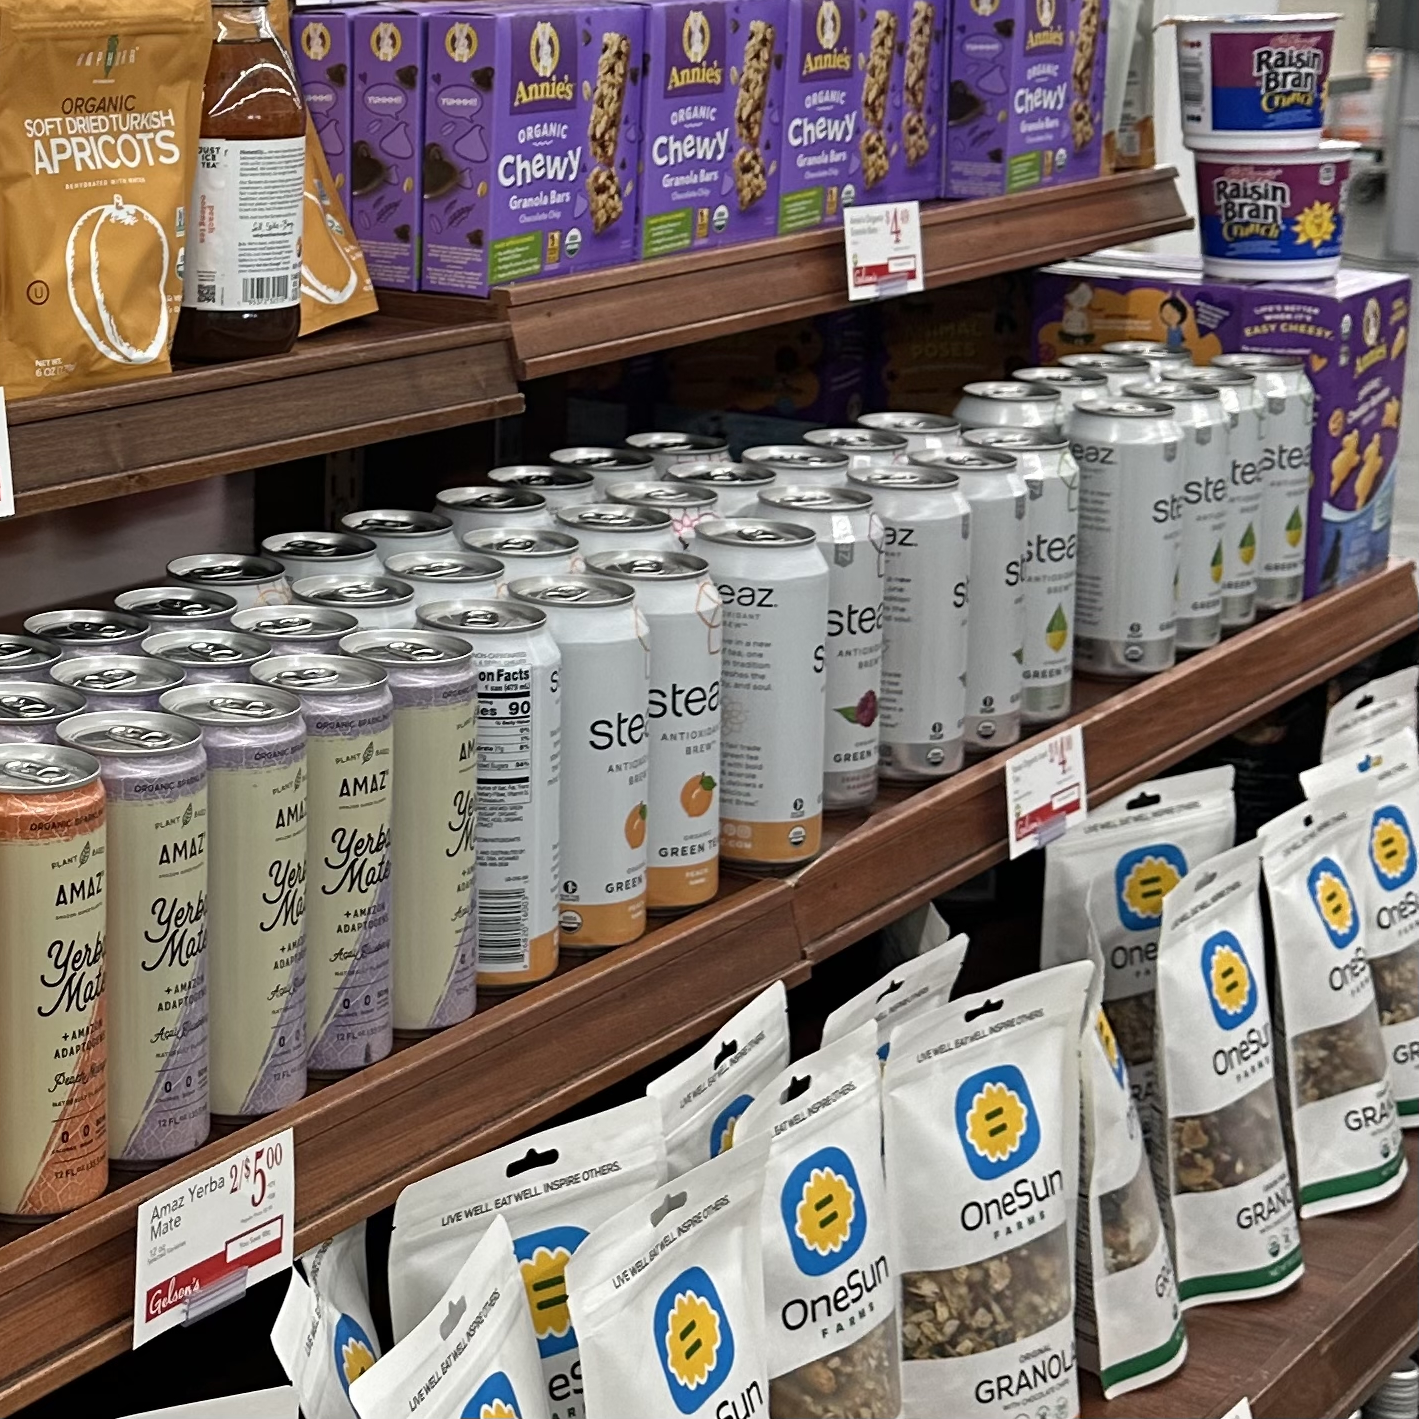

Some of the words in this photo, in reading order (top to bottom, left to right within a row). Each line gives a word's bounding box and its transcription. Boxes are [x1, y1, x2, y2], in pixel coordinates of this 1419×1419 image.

[1025, 26, 1064, 51] Annie's
[802, 47, 851, 76] Annie's
[1027, 63, 1059, 79] ORGANIC
[668, 61, 722, 90] Annie's
[1265, 71, 1313, 92] Bran
[61, 94, 136, 116] ORGANIC
[513, 78, 574, 107] Annie's
[805, 90, 847, 109] ORGANIC
[1014, 83, 1067, 114] Chewy
[24, 116, 64, 138] SOFT
[66, 114, 110, 136] DRIED
[111, 109, 175, 132] TURKISH
[670, 106, 717, 126] ORGANIC
[788, 110, 857, 147] Chewy
[518, 122, 568, 144] ORGANIC
[34, 129, 180, 175] APRICOTS
[652, 128, 729, 167] Chewy
[497, 146, 582, 187] Chewy
[509, 194, 549, 211] Granola
[550, 190, 571, 204] Bars
[1216, 180, 1286, 204] Raisin
[1223, 201, 1278, 222] Bran
[1223, 221, 1280, 242] Crunch
[497, 668, 530, 682] Facts
[508, 701, 531, 715] 90
[833, 751, 873, 762] GREEN
[339, 771, 386, 797] AMAZ
[658, 844, 705, 858] GREEN
[150, 1195, 184, 1224] Amaz
[188, 1175, 225, 1203] Yerba
[441, 1211, 463, 1227] LIVE
[494, 1194, 513, 1210] EAT
[543, 1173, 582, 1194] INSPIRE
[960, 1167, 1064, 1233] OneSun
[150, 1214, 182, 1241] Mate
[993, 1210, 1046, 1241] FARMS
[149, 1276, 201, 1315] Gelson's
[782, 1252, 890, 1331] OneSun
[821, 1303, 877, 1338] FARMS
[1018, 1345, 1052, 1365] ORIGINAL
